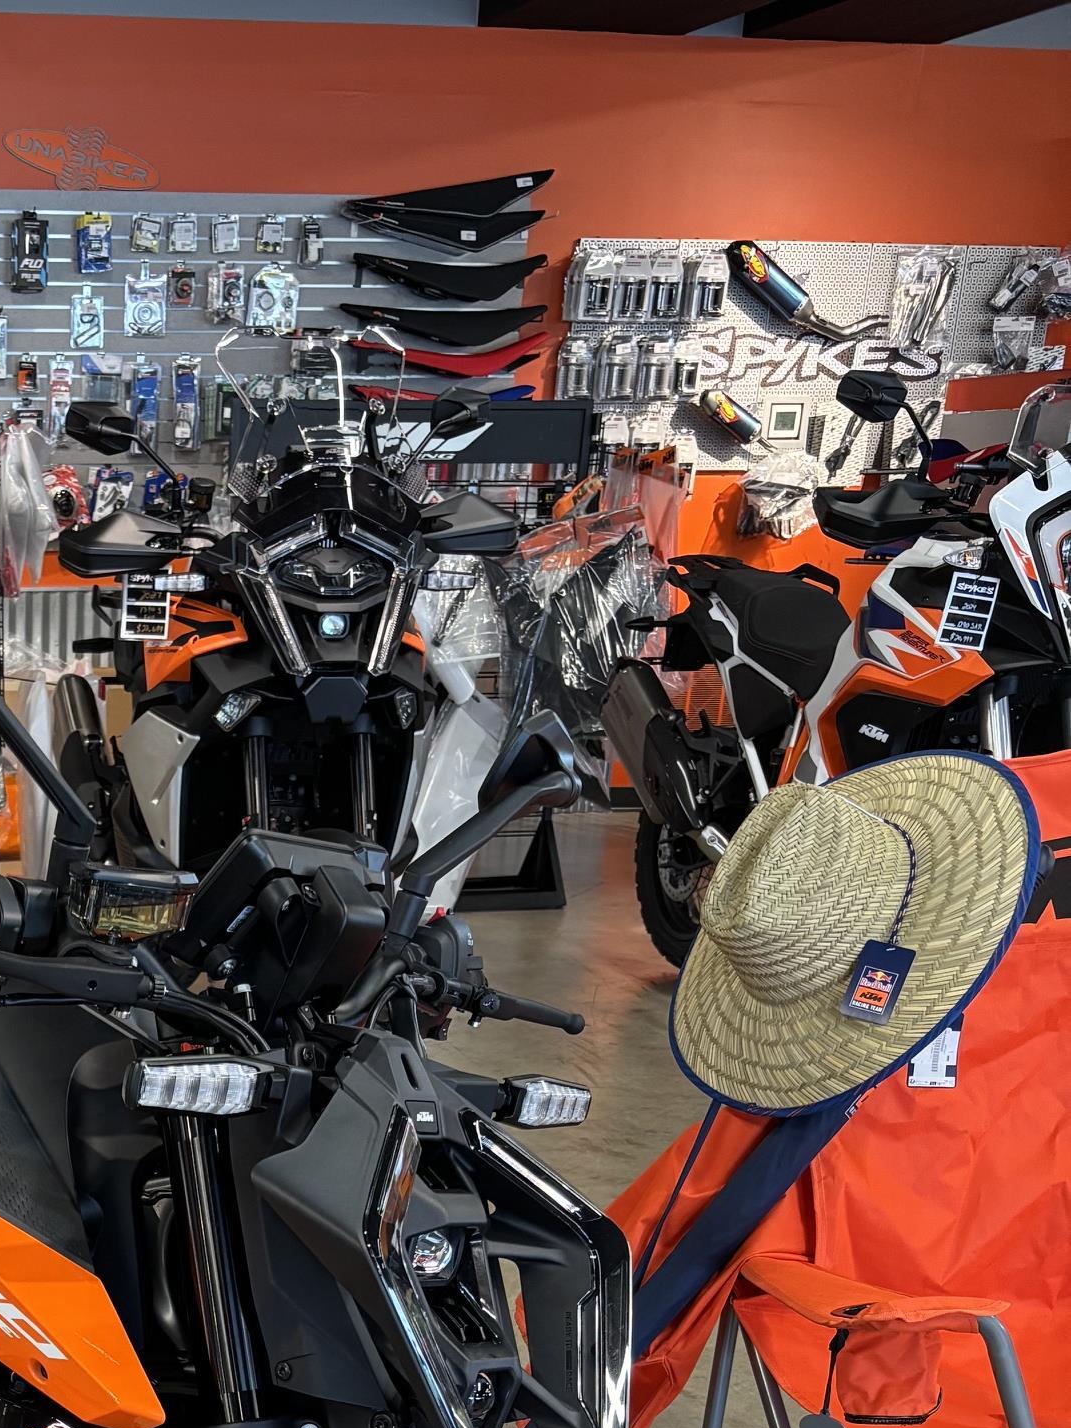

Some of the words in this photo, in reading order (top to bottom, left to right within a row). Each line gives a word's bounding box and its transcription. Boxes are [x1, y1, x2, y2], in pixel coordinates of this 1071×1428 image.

[20, 257, 44, 269] FLO
[699, 326, 943, 388] SPYKES
[130, 573, 155, 584] SPYK
[957, 583, 994, 594] SPYKES
[858, 723, 890, 744] KTM
[416, 1111, 434, 1123] KTM
